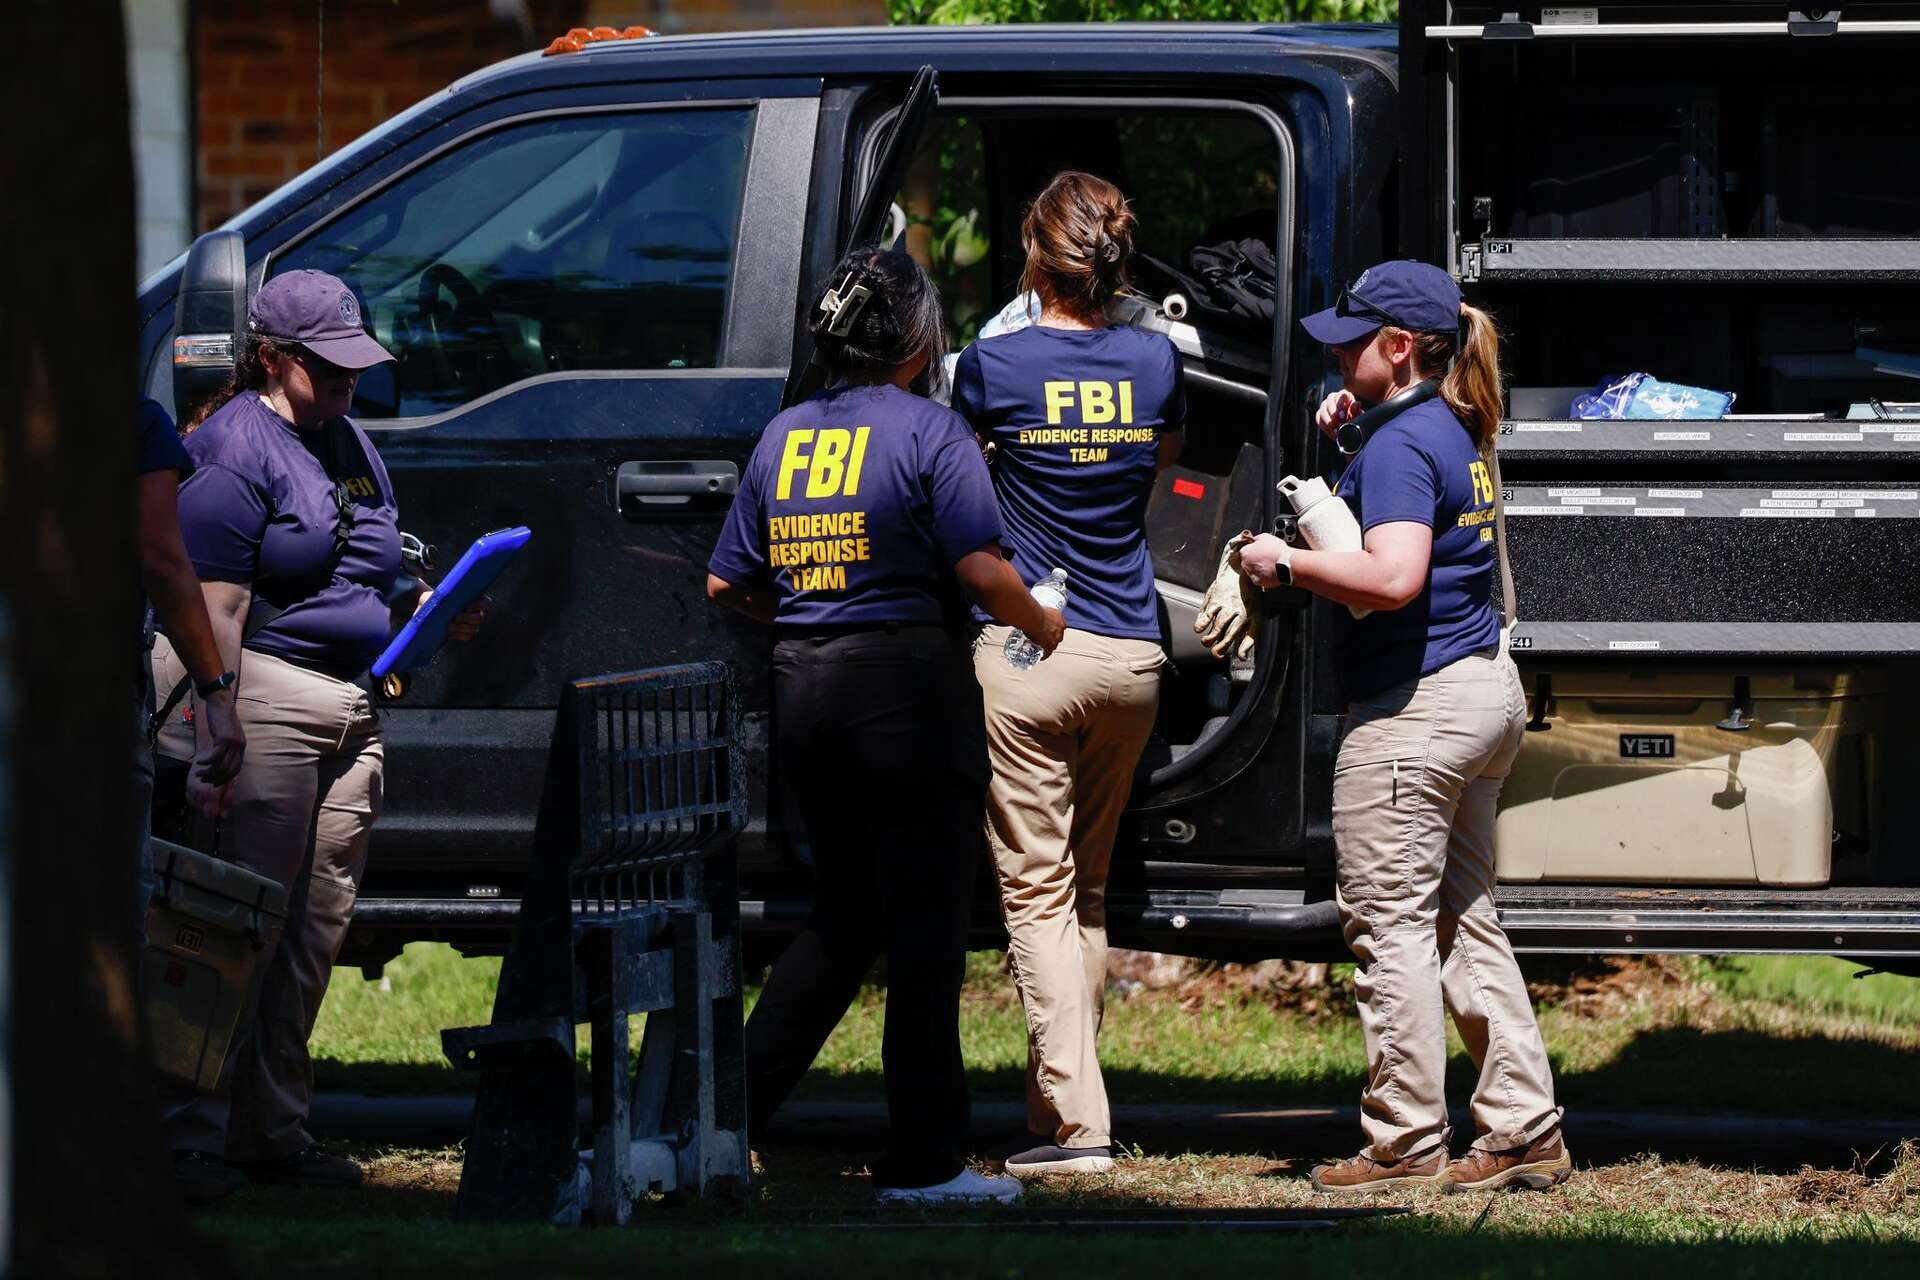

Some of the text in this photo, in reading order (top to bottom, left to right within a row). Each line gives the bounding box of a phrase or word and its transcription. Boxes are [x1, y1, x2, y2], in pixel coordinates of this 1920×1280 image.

[1490, 243, 1509, 253] DF1
[1044, 380, 1133, 424] FBI
[1019, 428, 1154, 444] EVIDENCE RESPONSE
[776, 426, 871, 500] FBI
[1069, 447, 1109, 463] TEAM
[1468, 461, 1494, 505] FB
[769, 511, 866, 541] EVIDENCE
[769, 537, 871, 568] RESPONSE
[787, 565, 847, 591] TEAM
[1622, 738, 1670, 754] YETI
